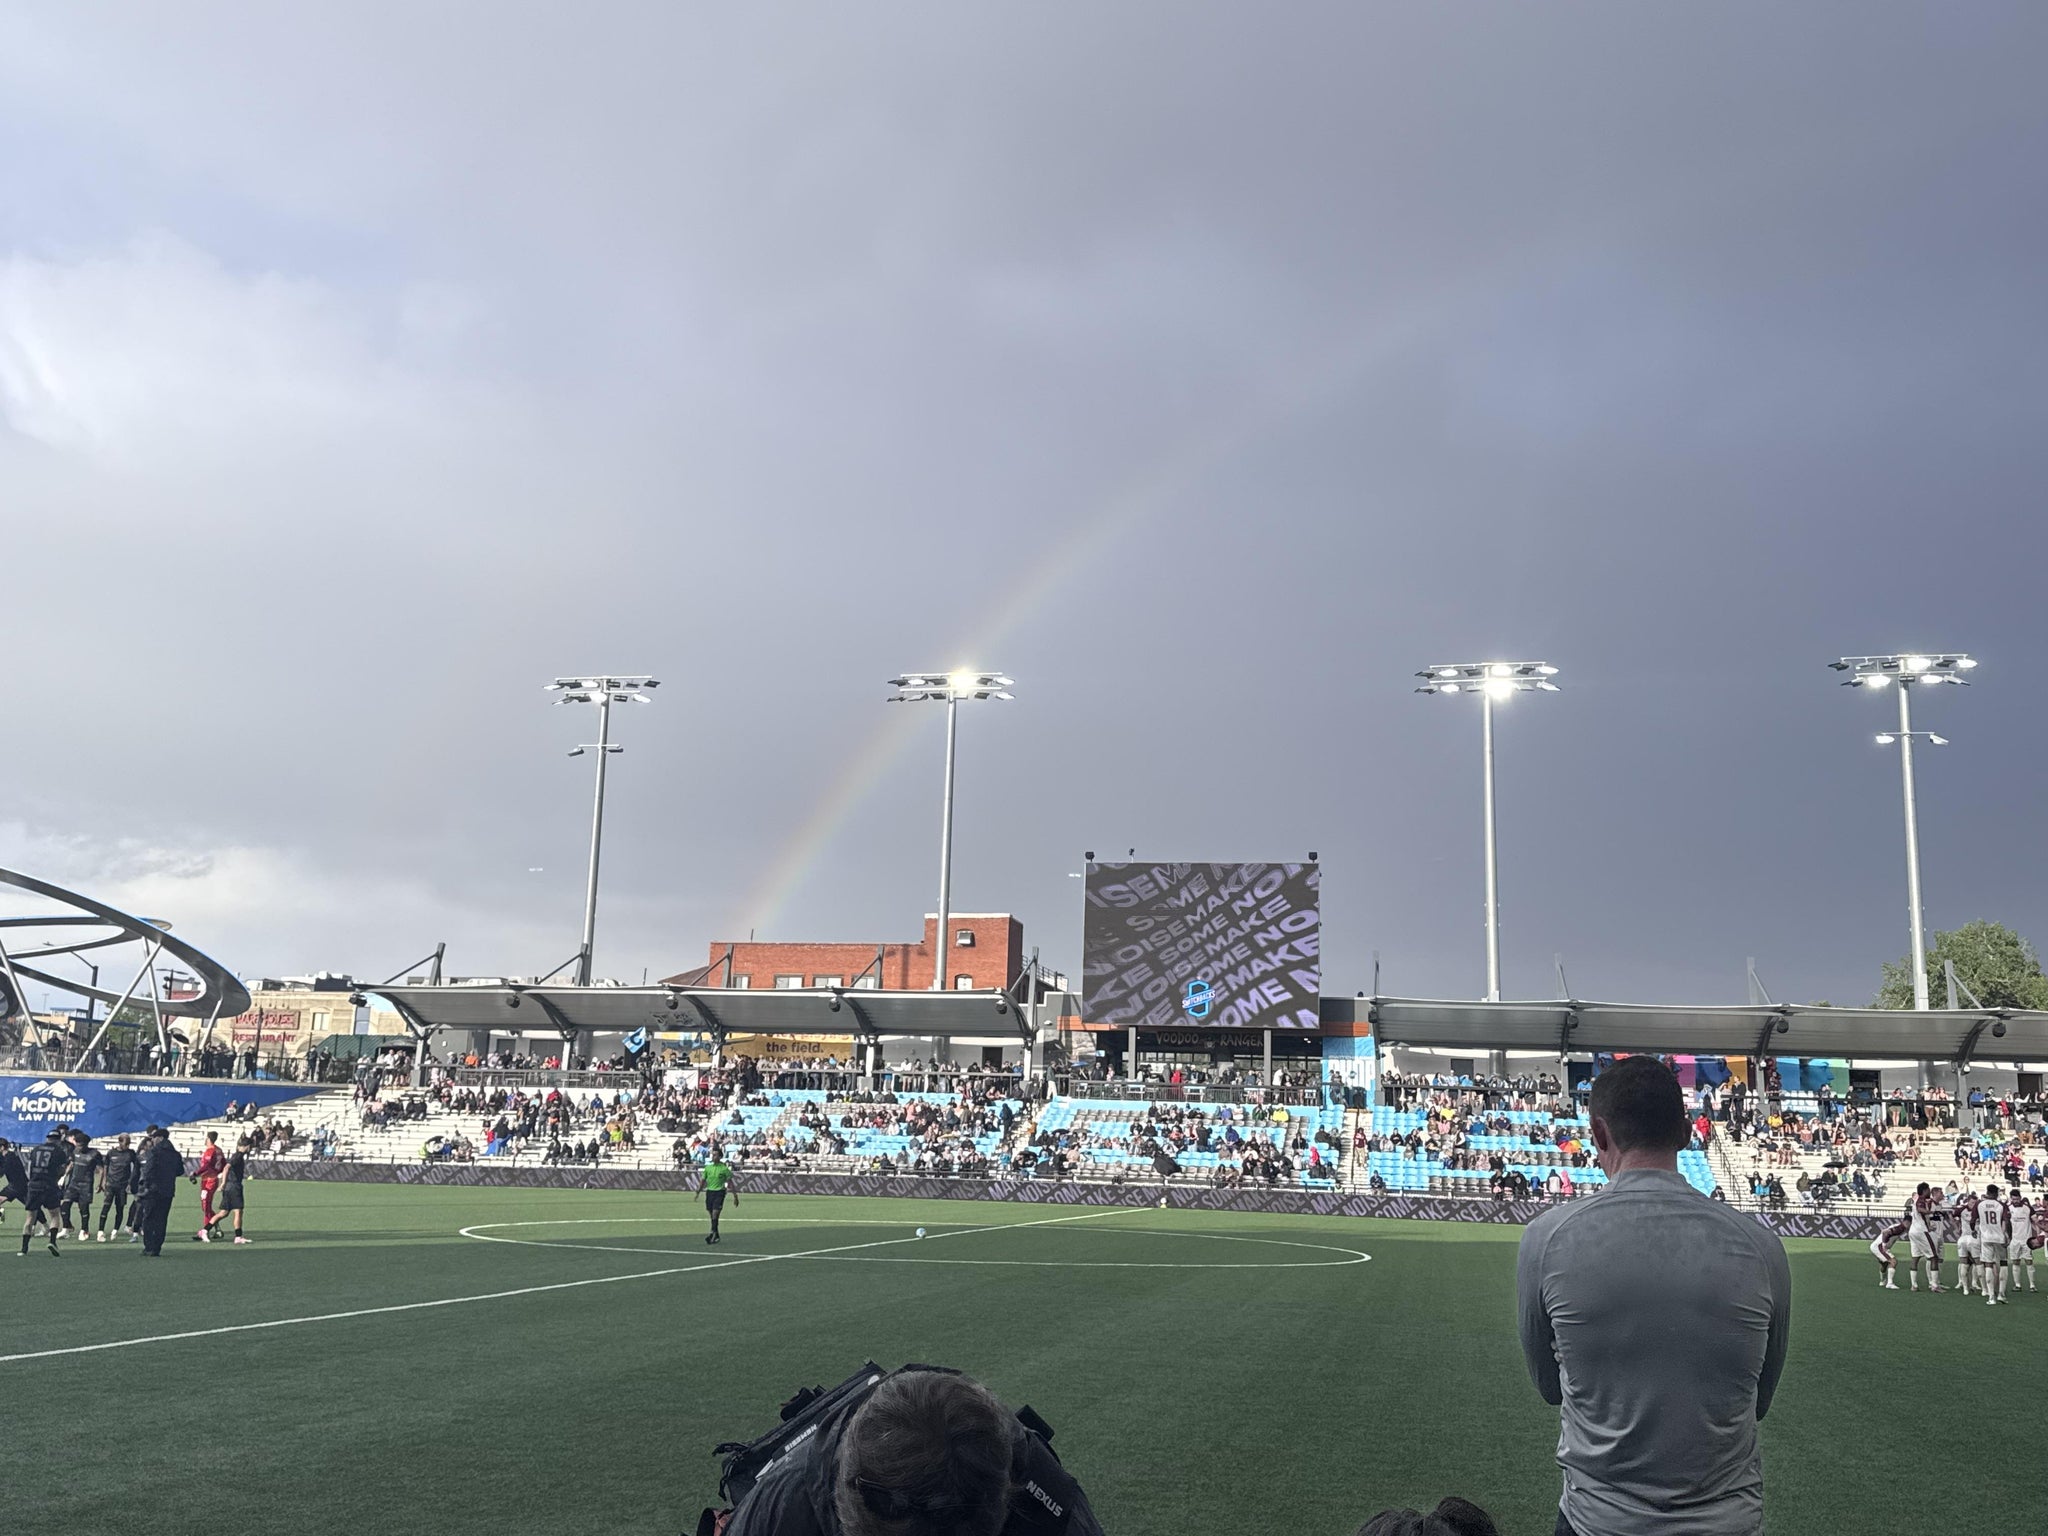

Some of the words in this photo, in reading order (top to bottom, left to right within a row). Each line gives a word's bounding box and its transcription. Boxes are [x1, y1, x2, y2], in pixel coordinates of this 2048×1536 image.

[1086, 874, 1160, 908] ISE
[1158, 911, 1230, 965] SOME
[1204, 893, 1292, 956] MAKE
[1224, 932, 1320, 992] MAKE
[1208, 977, 1294, 1027] OME
[766, 1042, 787, 1052] the
[791, 1042, 824, 1053] field.
[1156, 1032, 1200, 1045] VOODOO
[1220, 1033, 1264, 1047] RANGER
[11, 1096, 87, 1114] McDivitt
[18, 1112, 44, 1122] LAW
[47, 1113, 76, 1122] FIRM
[1984, 1211, 1997, 1225] 18
[1026, 1480, 1063, 1517] NEXUS
